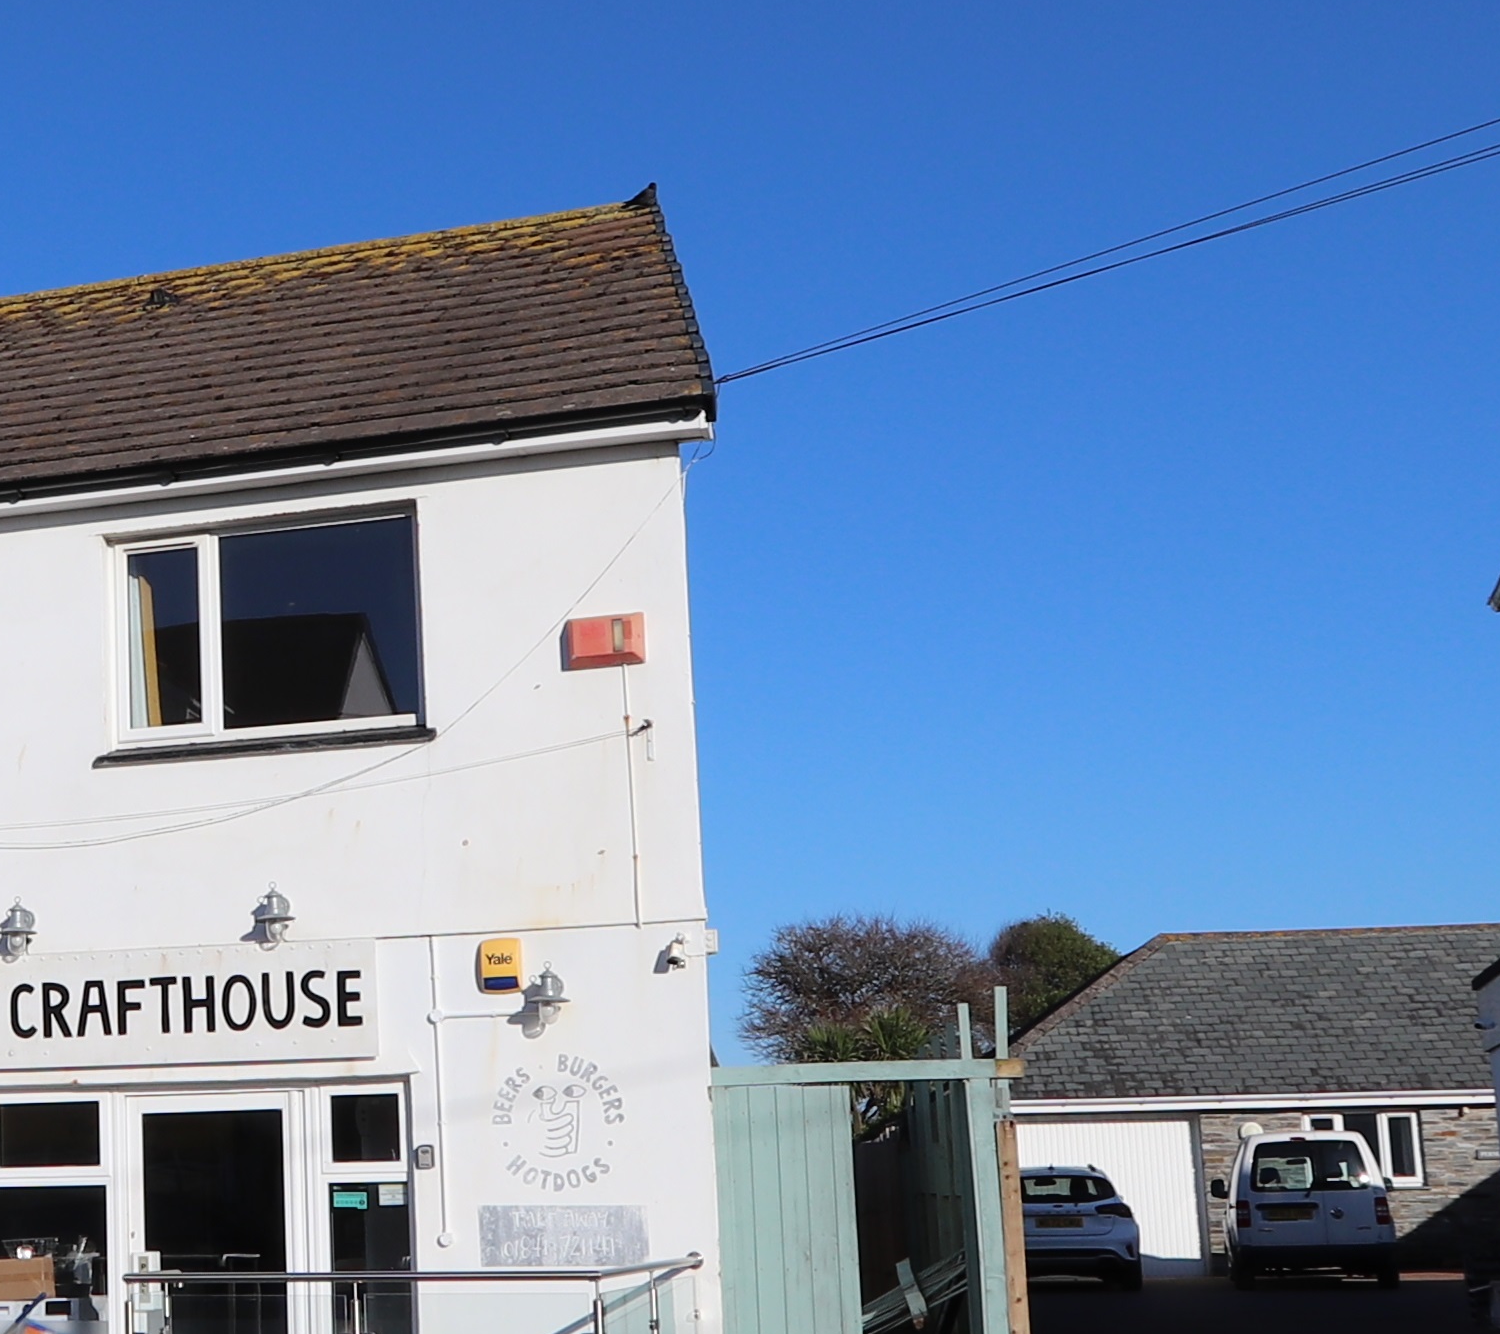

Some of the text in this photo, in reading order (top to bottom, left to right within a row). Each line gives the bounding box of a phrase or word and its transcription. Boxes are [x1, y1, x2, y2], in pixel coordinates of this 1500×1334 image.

[485, 952, 513, 965] Yale
[10, 970, 363, 1039] CRAFTHOUSE
[492, 1067, 530, 1125] BEERS
[557, 1053, 625, 1125] BURGERS
[506, 1157, 611, 1192] HOTDOGS
